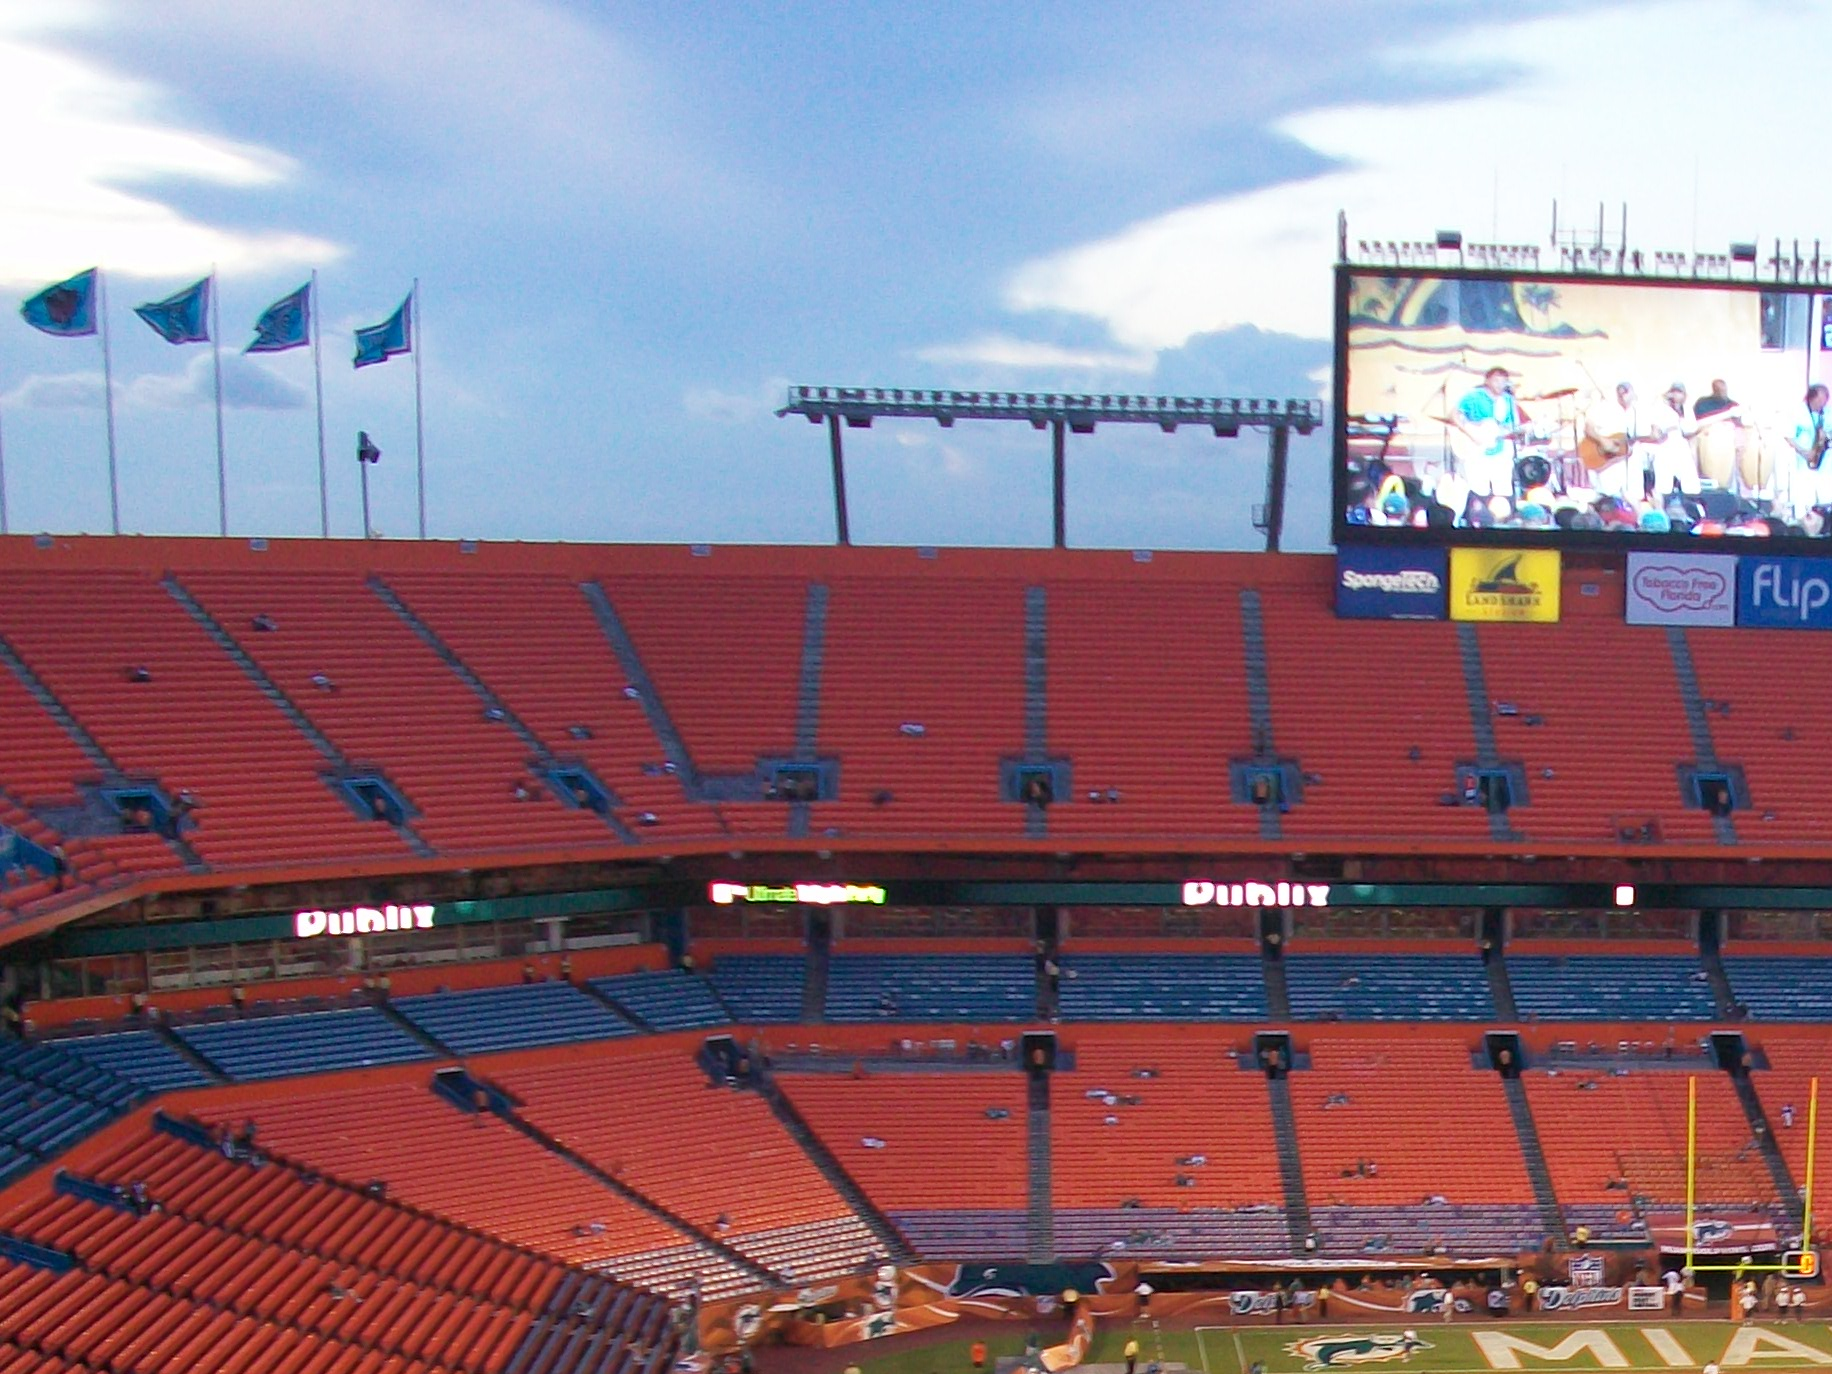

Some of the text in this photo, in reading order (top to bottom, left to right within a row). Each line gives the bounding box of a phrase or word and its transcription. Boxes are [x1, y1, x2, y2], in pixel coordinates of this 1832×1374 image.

[1642, 577, 1716, 590] Tobacco Free
[1661, 589, 1701, 601] Florida
[1182, 881, 1330, 907] Publix
[295, 904, 434, 938] Publix
